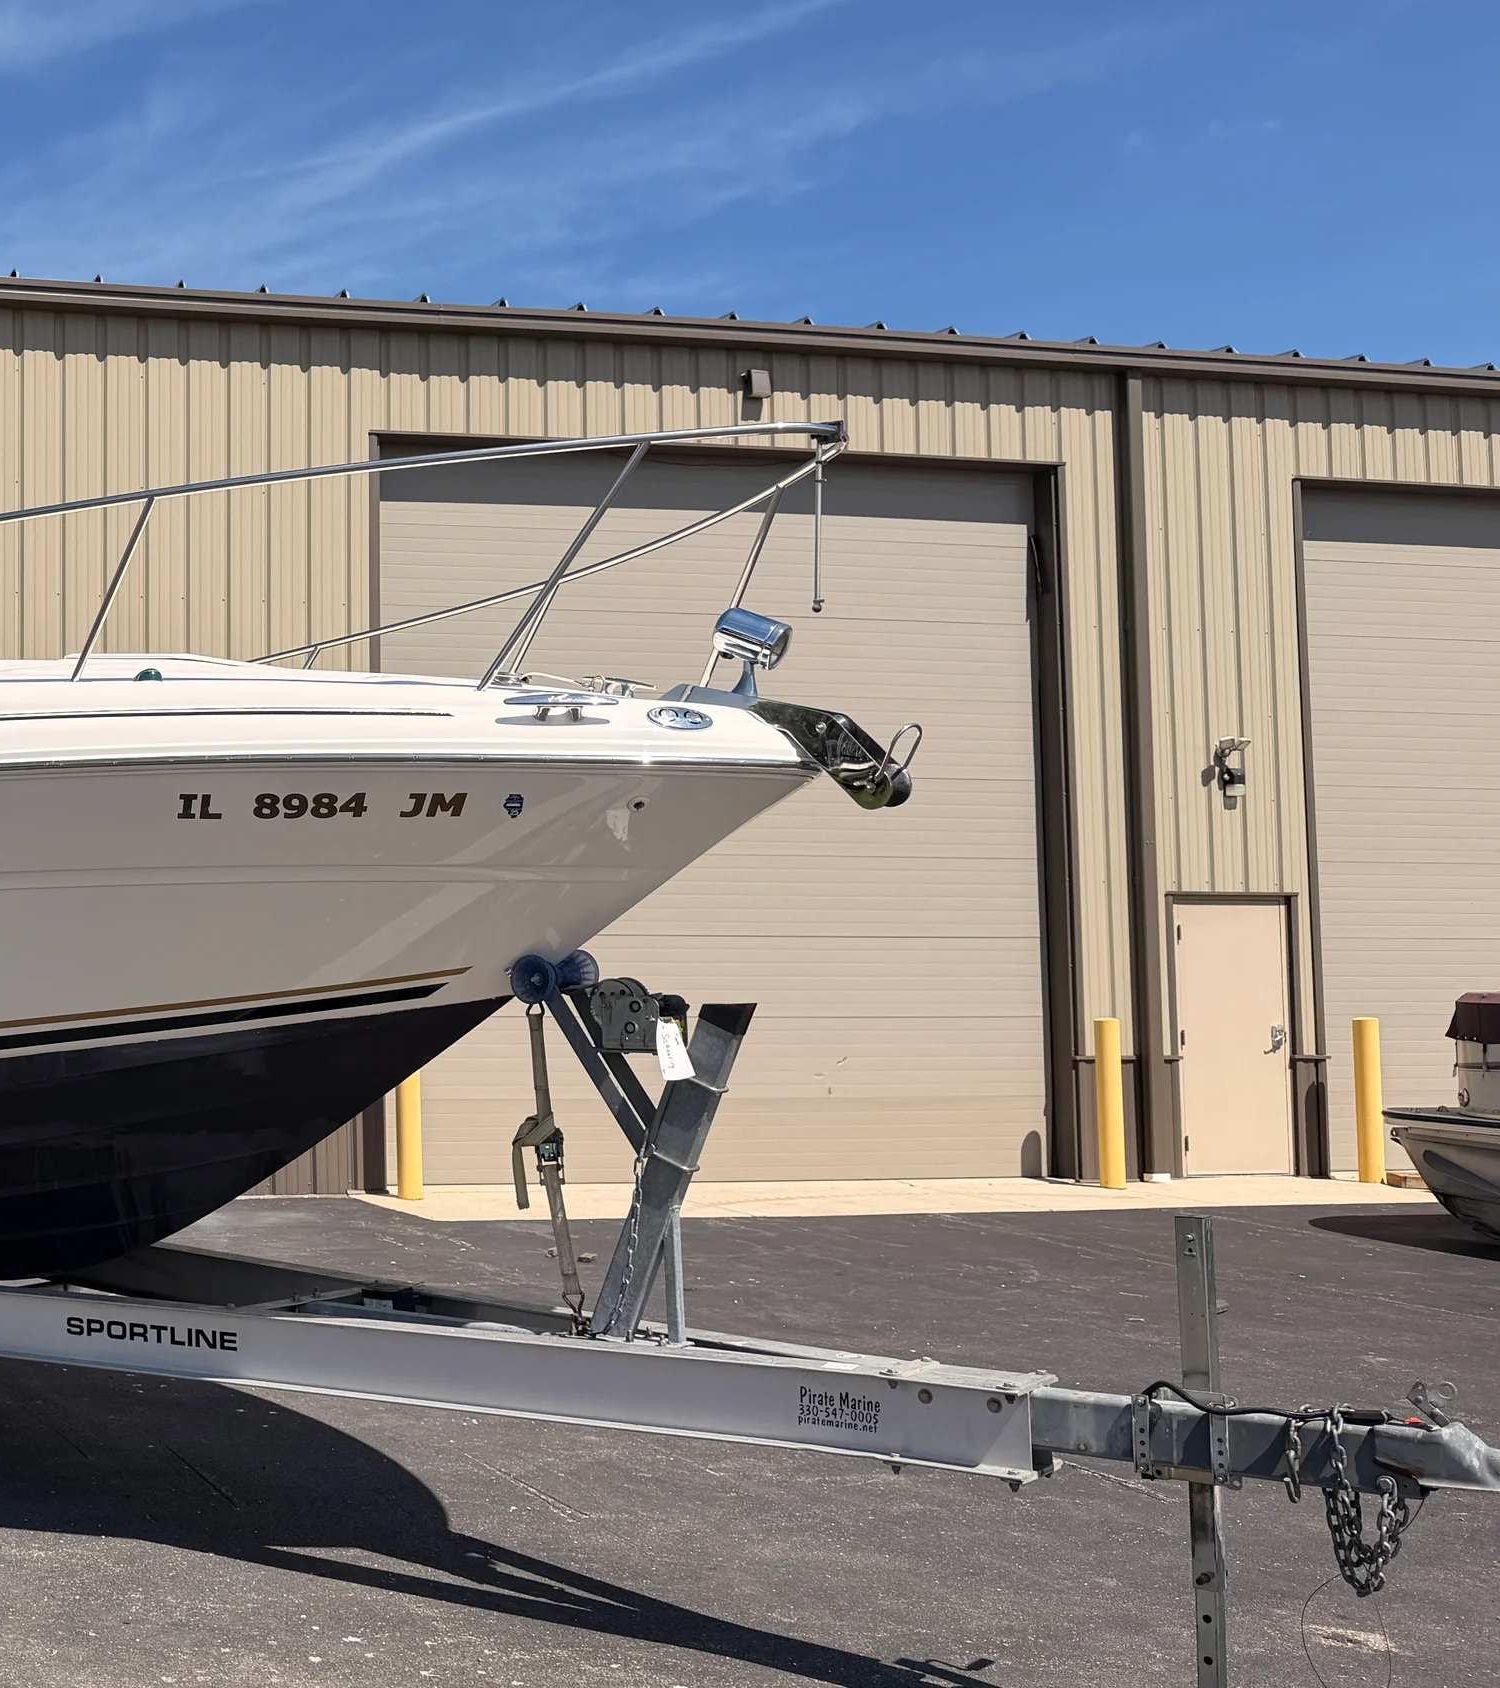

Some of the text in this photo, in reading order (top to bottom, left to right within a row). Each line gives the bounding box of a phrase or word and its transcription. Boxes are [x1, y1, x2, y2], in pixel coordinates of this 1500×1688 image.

[177, 792, 467, 819] IL 8984 JM
[66, 1316, 238, 1352] SPORTLINE
[800, 1386, 880, 1413] Pirate Marine
[798, 1416, 878, 1433] piratemarine.net
[799, 1404, 879, 1424] 330-547-0005
